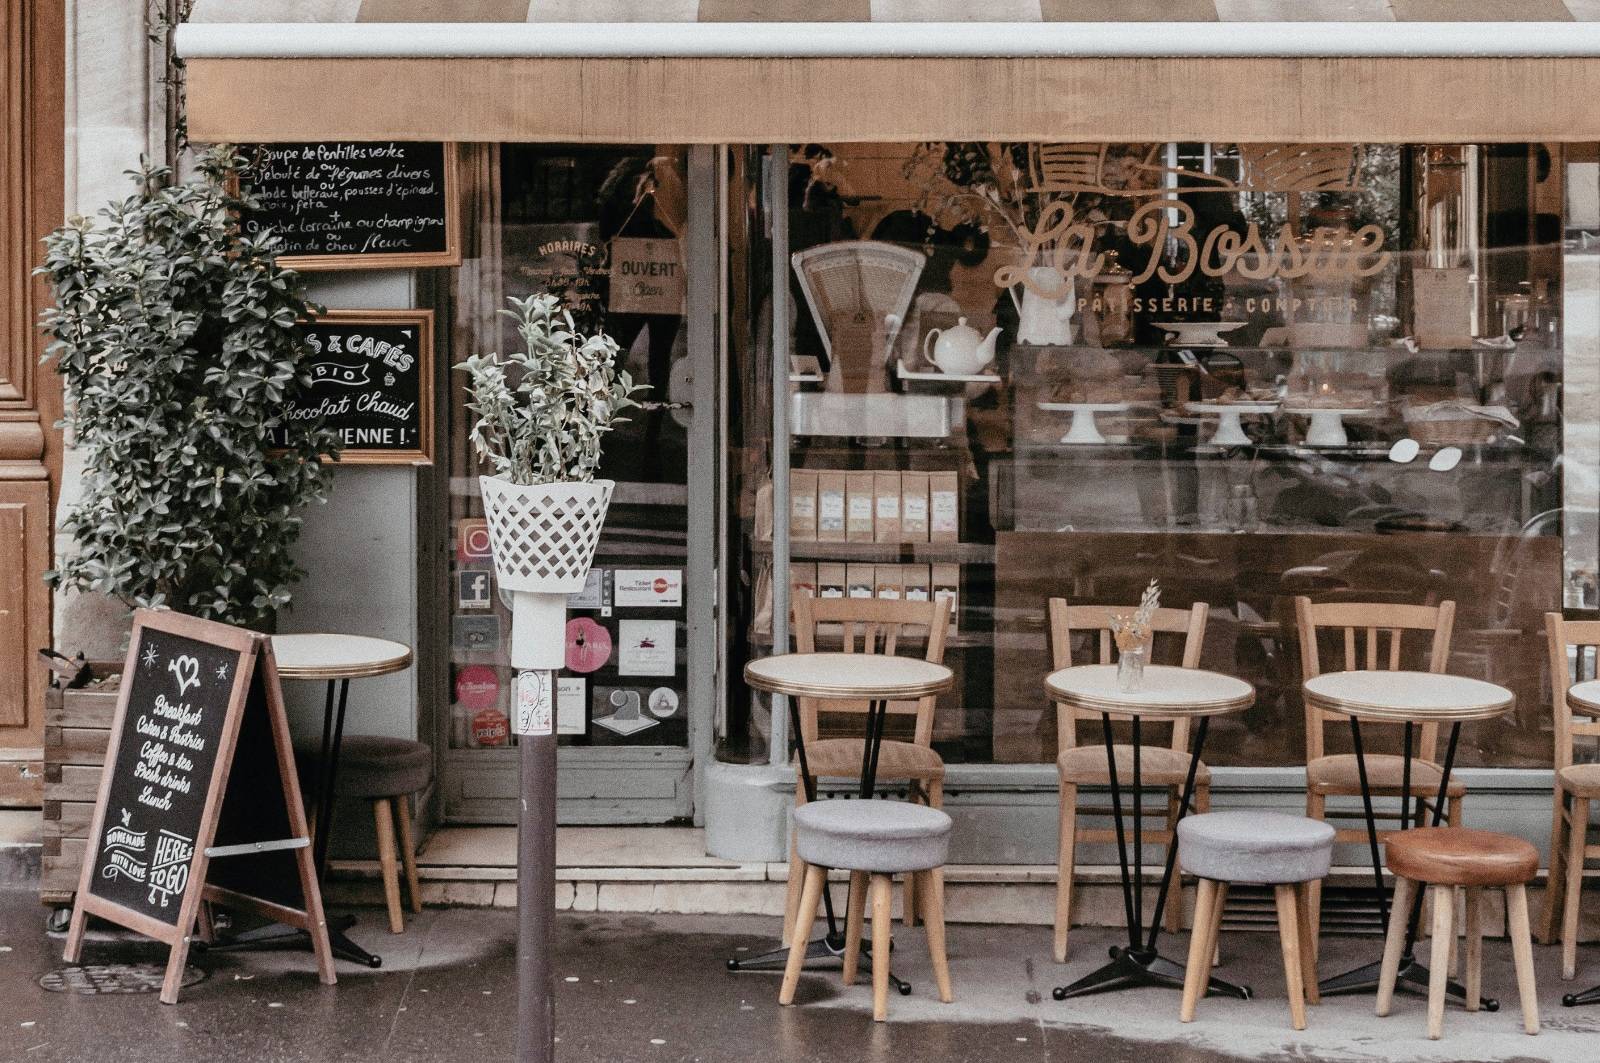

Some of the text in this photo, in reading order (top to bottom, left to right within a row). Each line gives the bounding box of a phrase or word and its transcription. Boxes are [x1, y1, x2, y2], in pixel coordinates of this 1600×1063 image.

[262, 146, 299, 166] oupe
[302, 146, 316, 160] de
[368, 142, 405, 159] vertes
[305, 166, 321, 180] de
[386, 163, 431, 180] divers
[320, 182, 335, 190] ou
[295, 199, 329, 215] feta
[356, 219, 374, 228] ou
[538, 240, 597, 257] HORAIRES
[994, 200, 1391, 301] La Bossue
[621, 261, 678, 277] OUVERT
[327, 335, 343, 354] &
[346, 334, 415, 373] CAFÉS
[316, 366, 355, 381] BIO
[285, 390, 415, 421] hocolat Chaud
[153, 694, 203, 730] Breakfast
[136, 715, 205, 751] Cakes & Pastries
[140, 740, 169, 768] Coffee
[175, 752, 194, 771] tea
[133, 760, 191, 794] Fresh drinks
[138, 785, 173, 811] Lunch
[106, 831, 146, 848] HOMEMADE
[152, 835, 188, 867] HERE
[111, 853, 147, 878] WITH LOVE
[150, 863, 188, 895] TO GO
